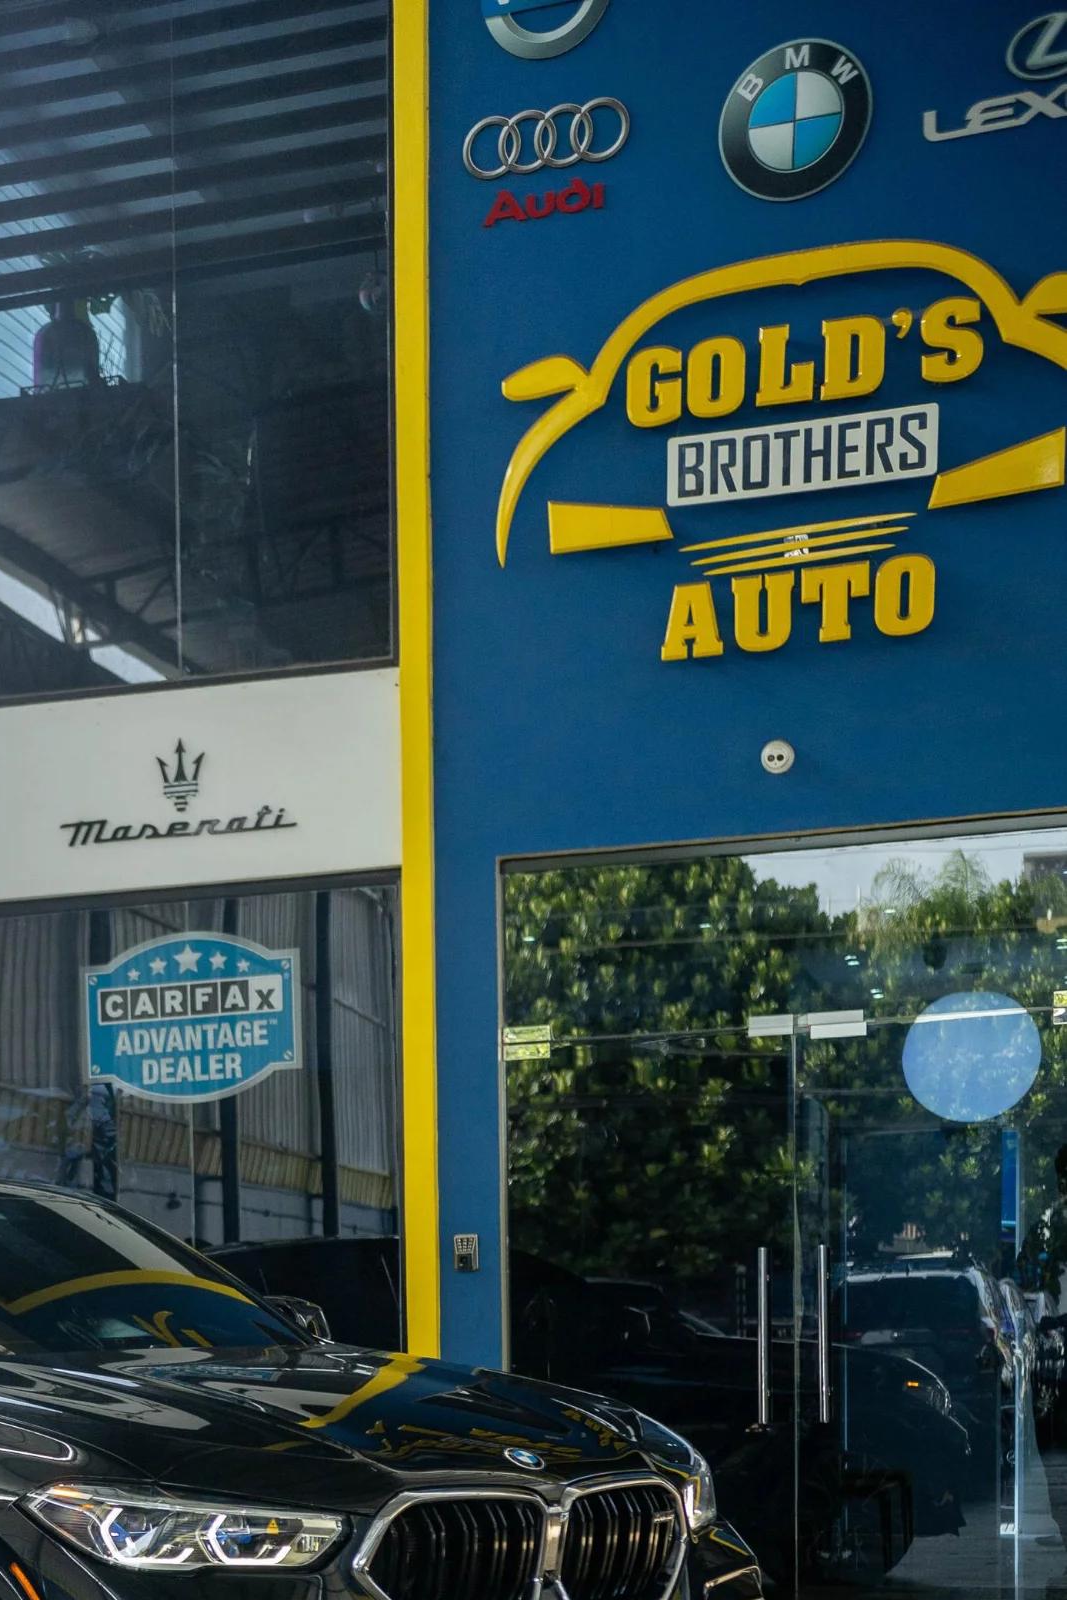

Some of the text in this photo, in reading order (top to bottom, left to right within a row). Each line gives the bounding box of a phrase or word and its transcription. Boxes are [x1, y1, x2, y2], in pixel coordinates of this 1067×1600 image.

[736, 44, 859, 101] BMW
[923, 83, 1067, 142] LEX
[484, 177, 605, 228] Audi
[626, 297, 985, 428] GOLD'S
[677, 411, 929, 499] BROTHERS
[660, 553, 935, 661] AUTO
[60, 805, 297, 847] Maserati
[105, 985, 276, 1018] CARFAX
[115, 1019, 269, 1056] ADVANTAGE
[142, 1053, 242, 1085] DEALER
